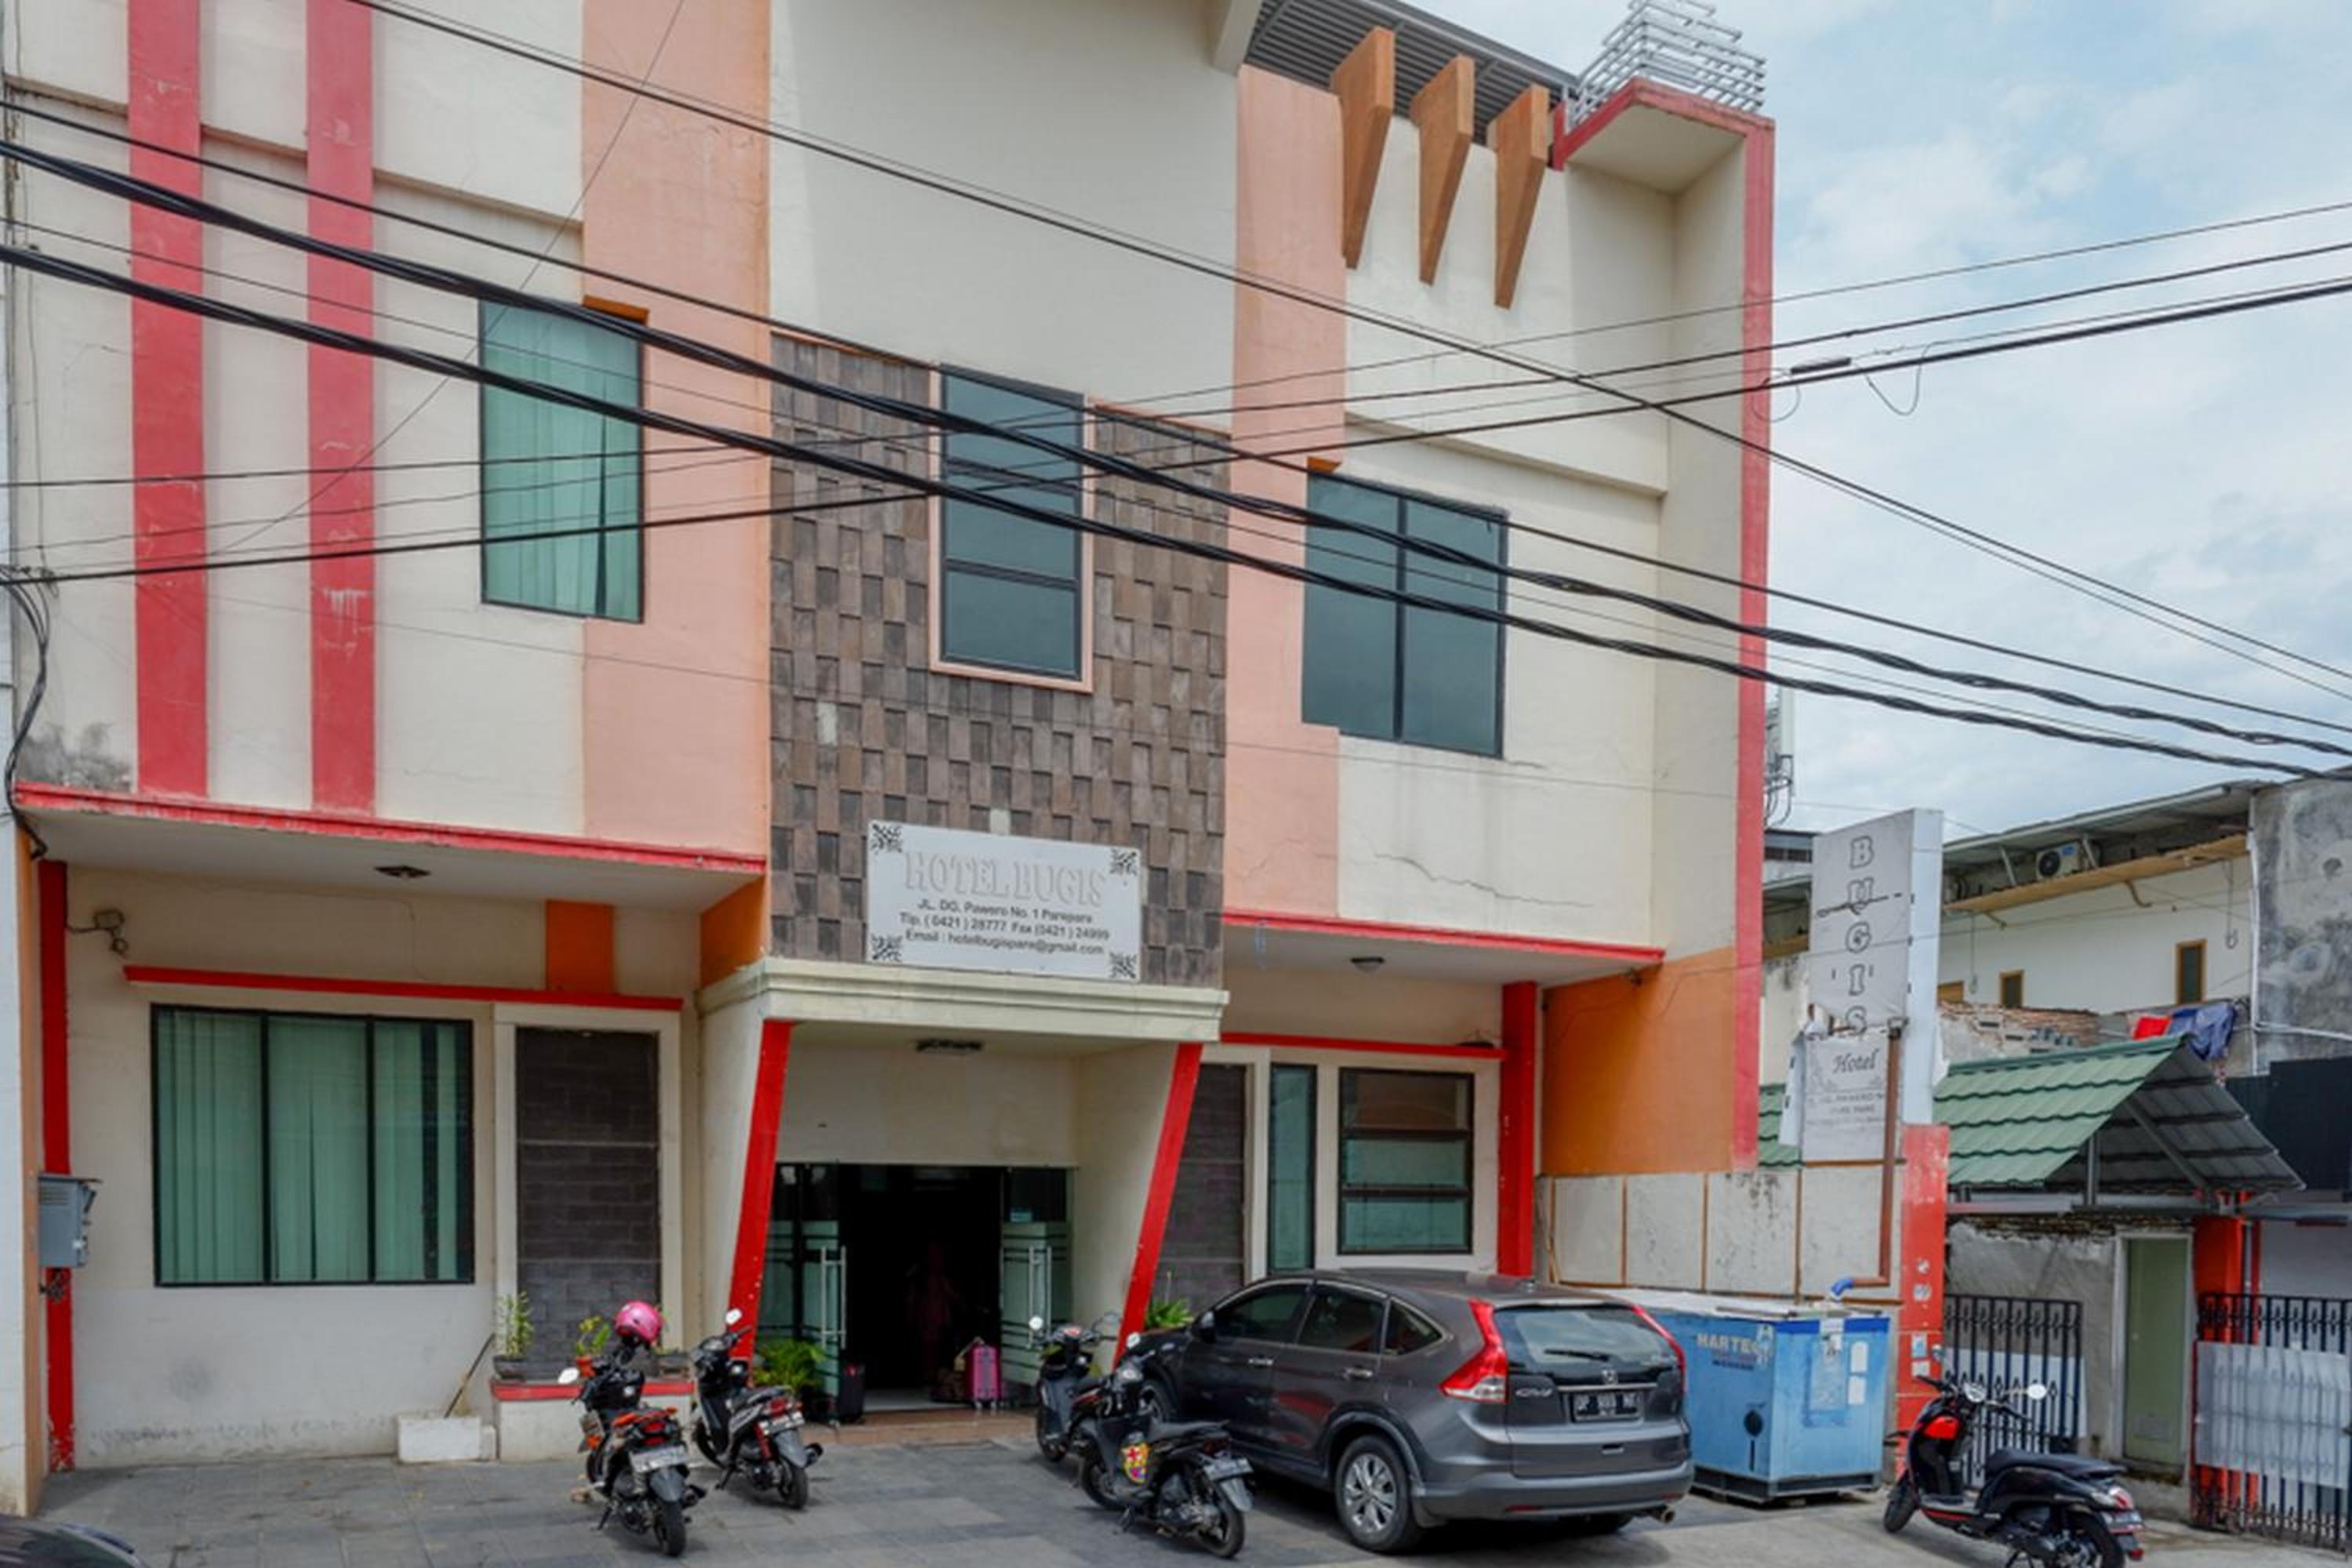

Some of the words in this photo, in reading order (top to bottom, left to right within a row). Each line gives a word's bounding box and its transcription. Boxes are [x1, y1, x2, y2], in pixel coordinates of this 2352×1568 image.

[905, 852, 1010, 898] HOTEL
[1012, 862, 1105, 908] BUGIS
[1832, 1047, 1880, 1074] Hotel
